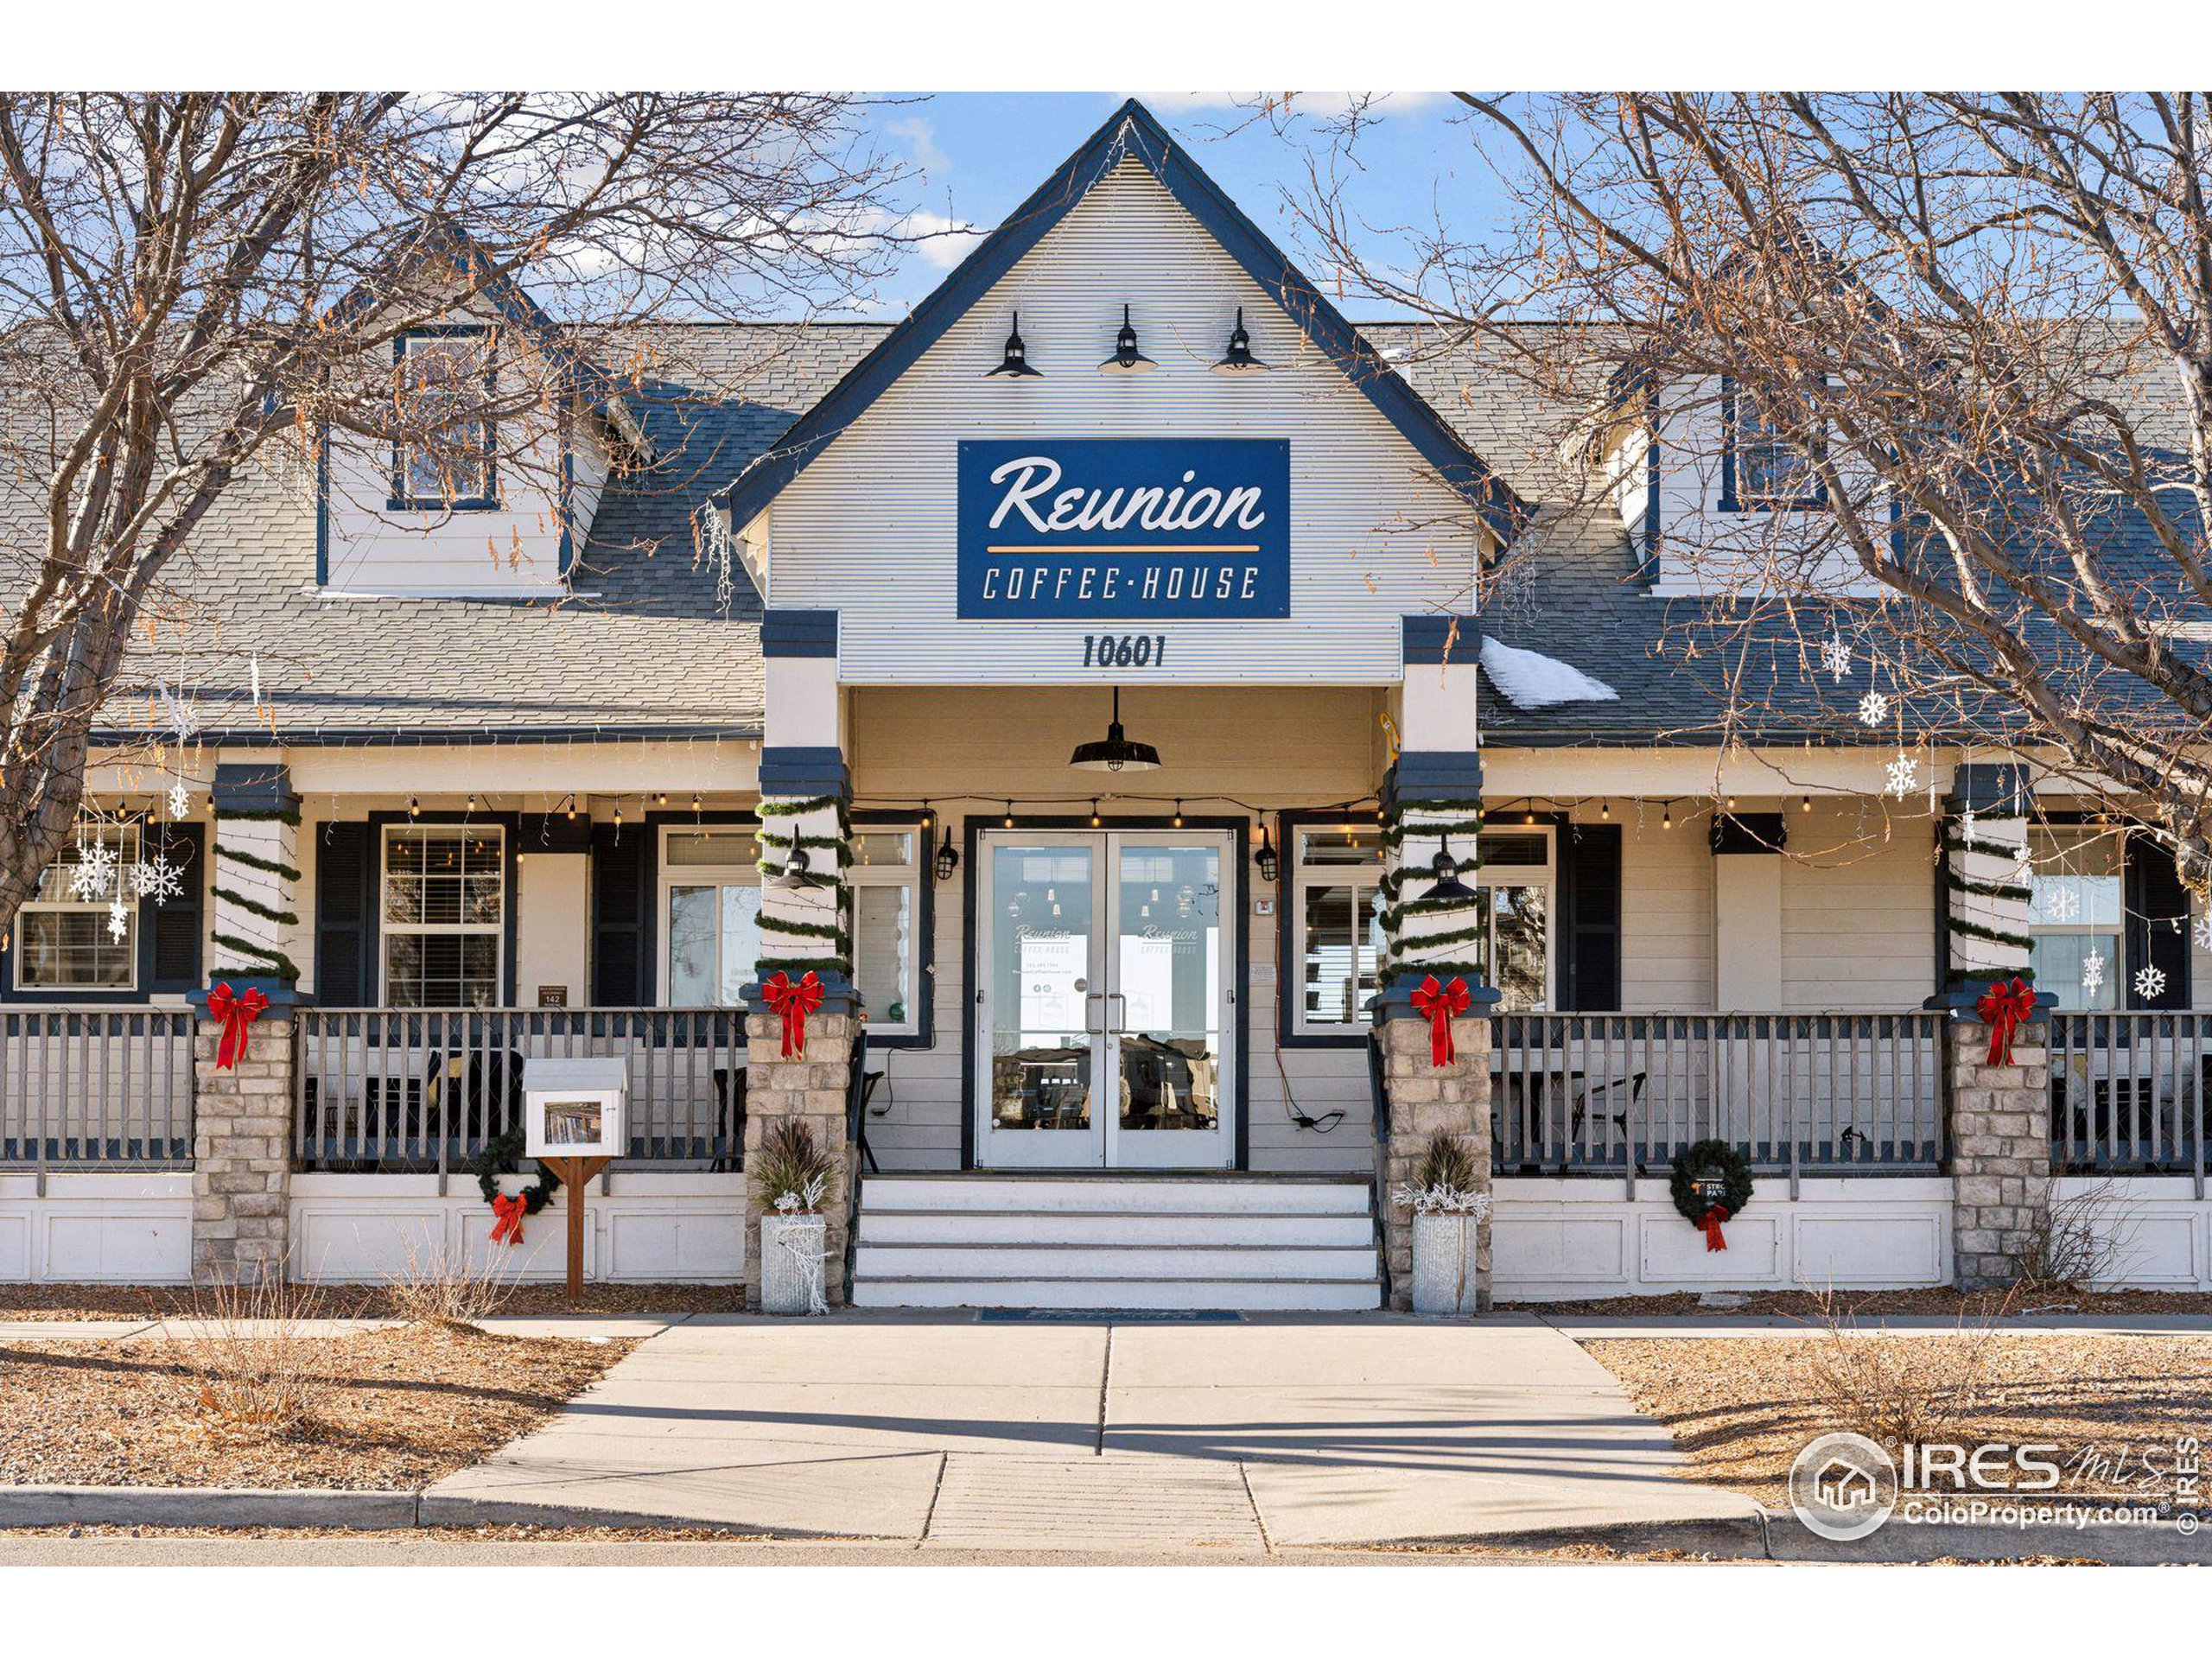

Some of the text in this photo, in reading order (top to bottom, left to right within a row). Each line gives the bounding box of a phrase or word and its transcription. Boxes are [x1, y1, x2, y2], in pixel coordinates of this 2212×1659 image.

[989, 456, 1265, 533] Reunion
[1084, 635, 1166, 667] 10601
[1015, 925, 1071, 940] Reunion
[1142, 924, 1198, 940] Reunion
